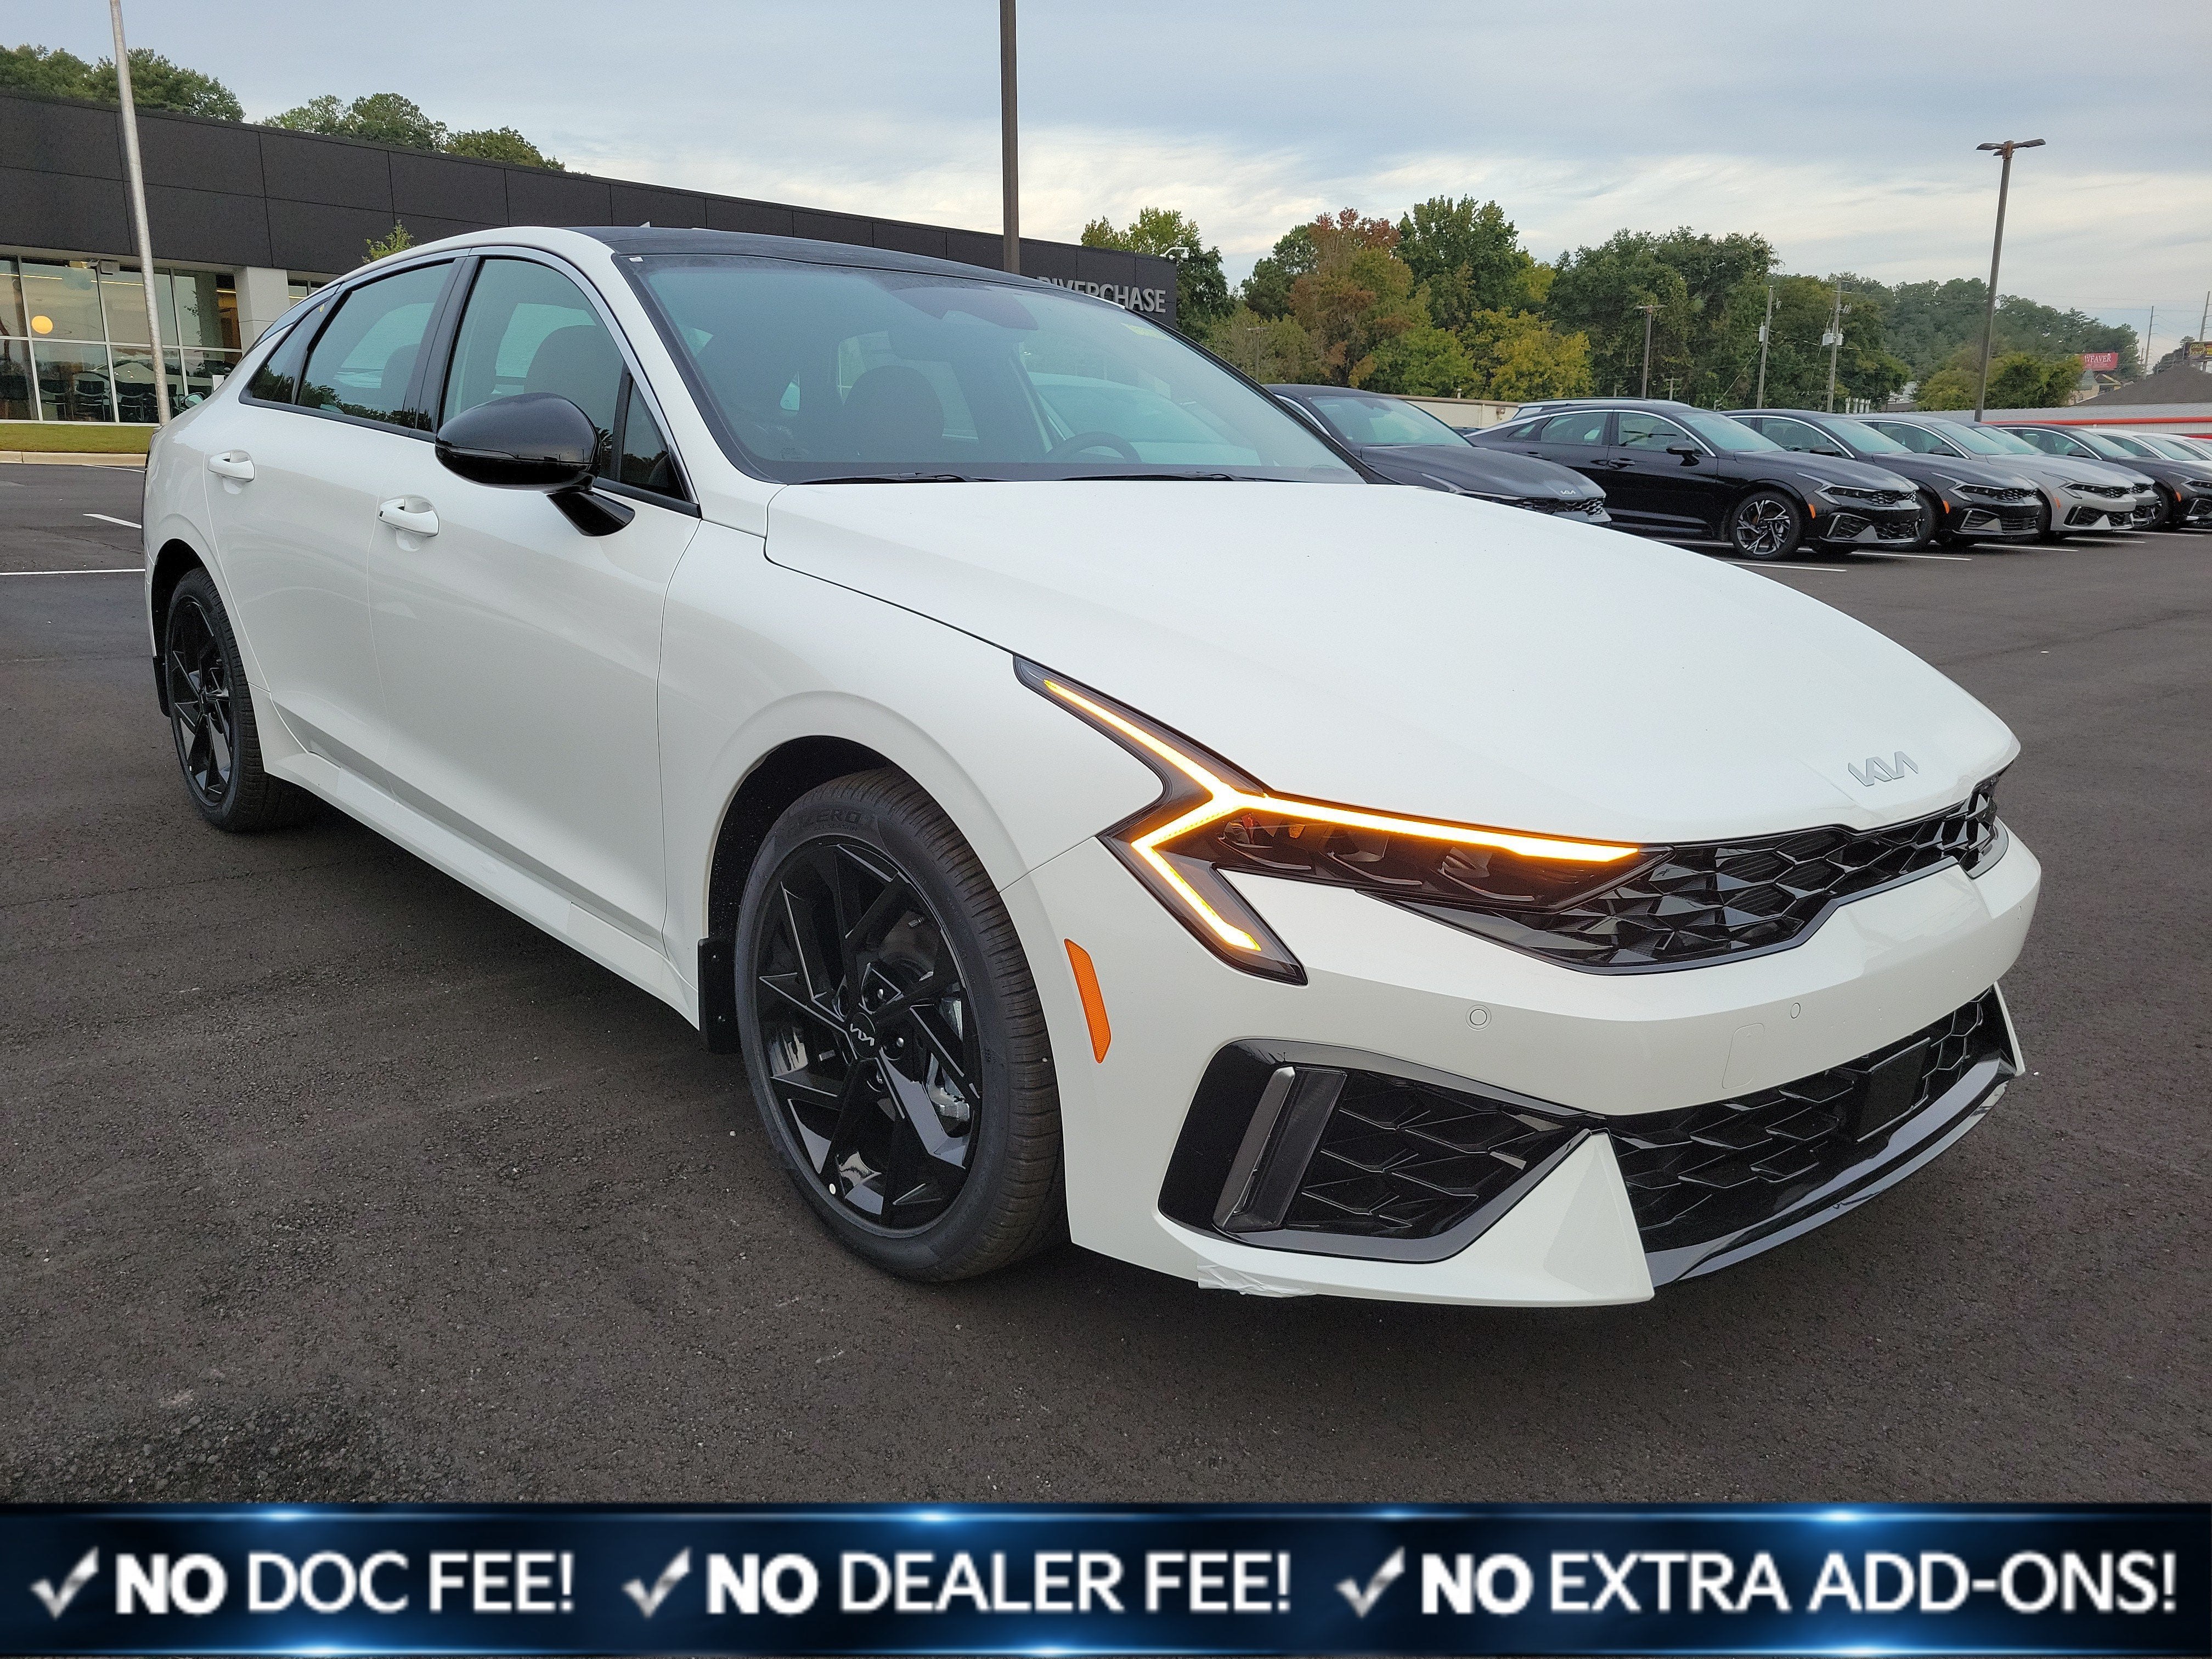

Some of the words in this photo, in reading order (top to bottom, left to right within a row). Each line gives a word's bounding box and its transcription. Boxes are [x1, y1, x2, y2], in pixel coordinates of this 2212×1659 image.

[1038, 275, 1166, 313] ERCHASE
[2084, 353, 2112, 363] WEAVER
[1848, 751, 1918, 787] KIA
[850, 1023, 875, 1046] KIA
